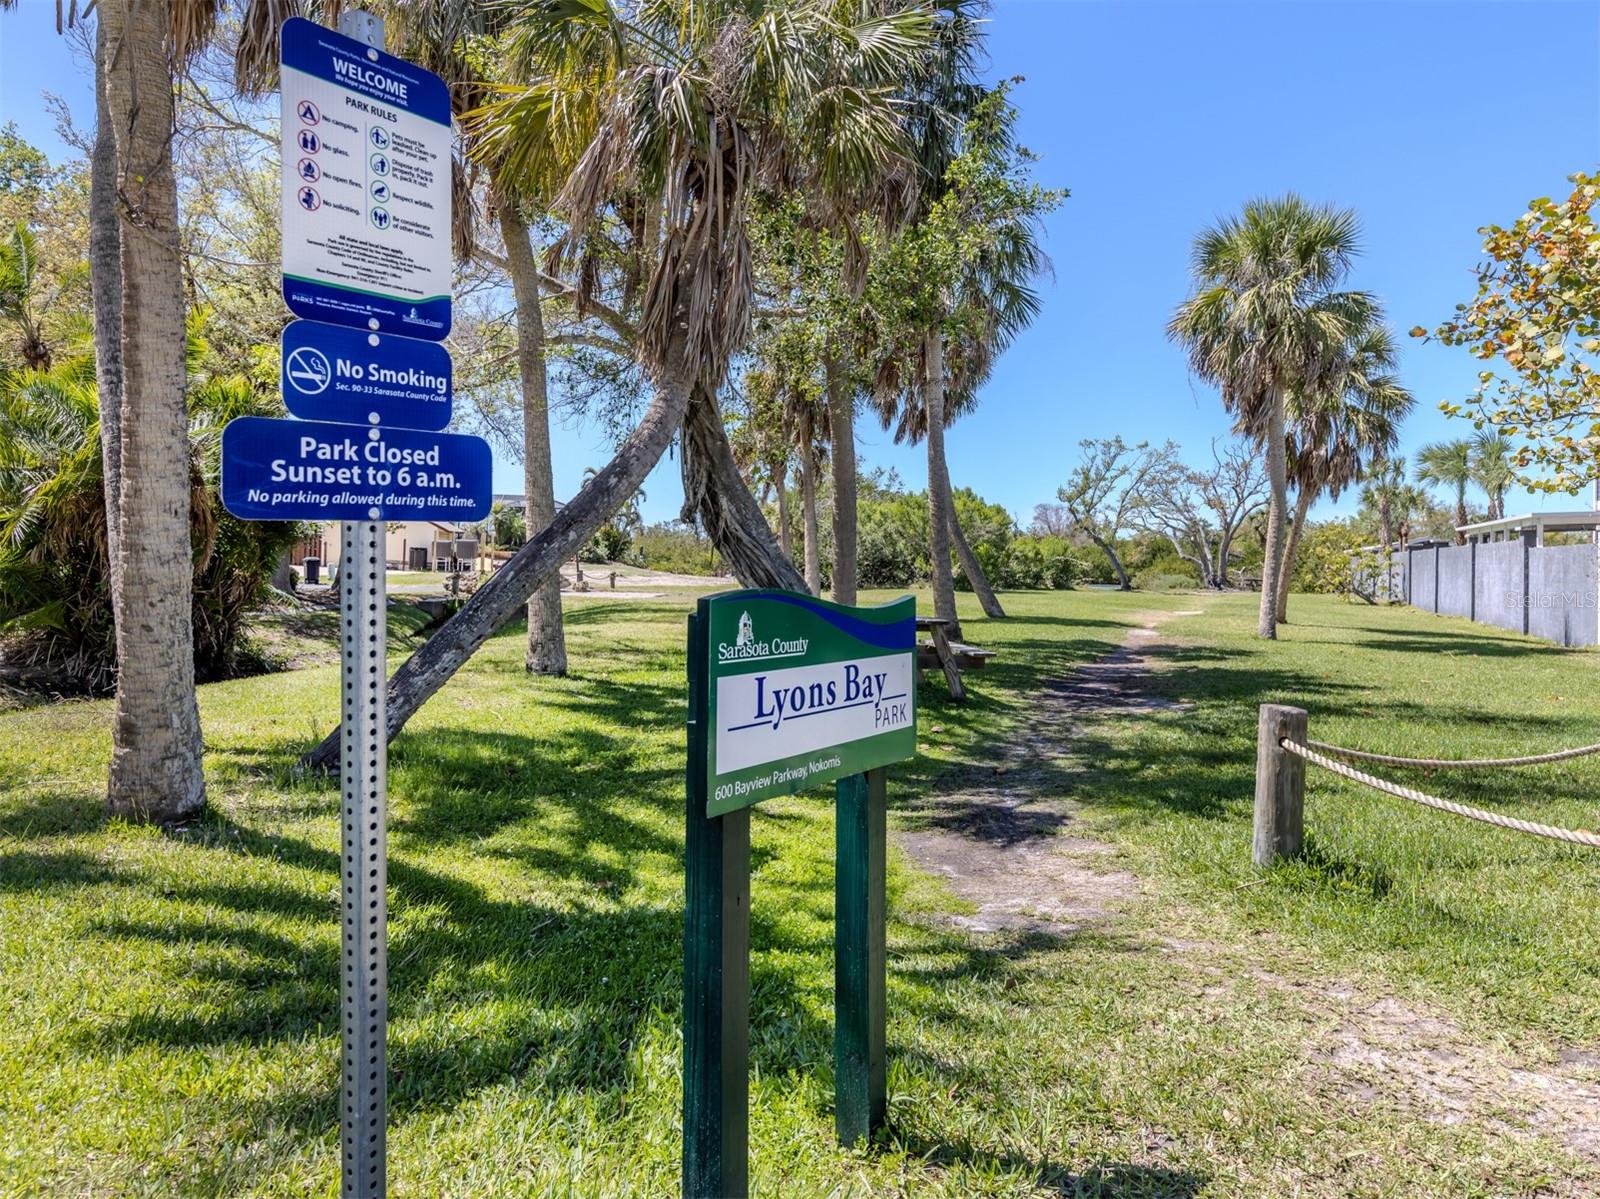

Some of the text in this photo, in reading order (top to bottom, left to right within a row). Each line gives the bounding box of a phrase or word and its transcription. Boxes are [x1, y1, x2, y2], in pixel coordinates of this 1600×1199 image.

[332, 57, 407, 98] WELCOME
[345, 77, 358, 87] hope
[359, 84, 369, 92] you
[369, 87, 383, 98] enjoy
[384, 92, 395, 102] your
[396, 96, 408, 106] visit.
[346, 97, 397, 122] PARK RULES
[322, 114, 359, 133] No camping.
[392, 132, 403, 140] Pets
[333, 147, 349, 157] glass.
[392, 139, 413, 151] leashed.
[415, 147, 429, 155] Clean
[392, 159, 412, 169] Dispose
[392, 167, 414, 177] properly.
[323, 171, 363, 188] No open fires.
[333, 201, 360, 215] soliciting.
[393, 192, 434, 209] Respect wildlife.
[401, 219, 430, 230] considerate
[415, 230, 434, 239] visitors.
[336, 359, 447, 394] No Smoking
[336, 382, 447, 402] Sec. 90-33 Sarasota County Code
[300, 437, 439, 465] Park Closed
[271, 460, 461, 488] Sunset to 6 a.m.
[248, 490, 476, 507] No parking allowed during this time.
[719, 637, 808, 659] Sarasota County
[755, 664, 887, 730] Lyons Bay
[875, 704, 907, 728] PARK
[715, 755, 841, 800] 600 Bayview Parkway, Nokomis
